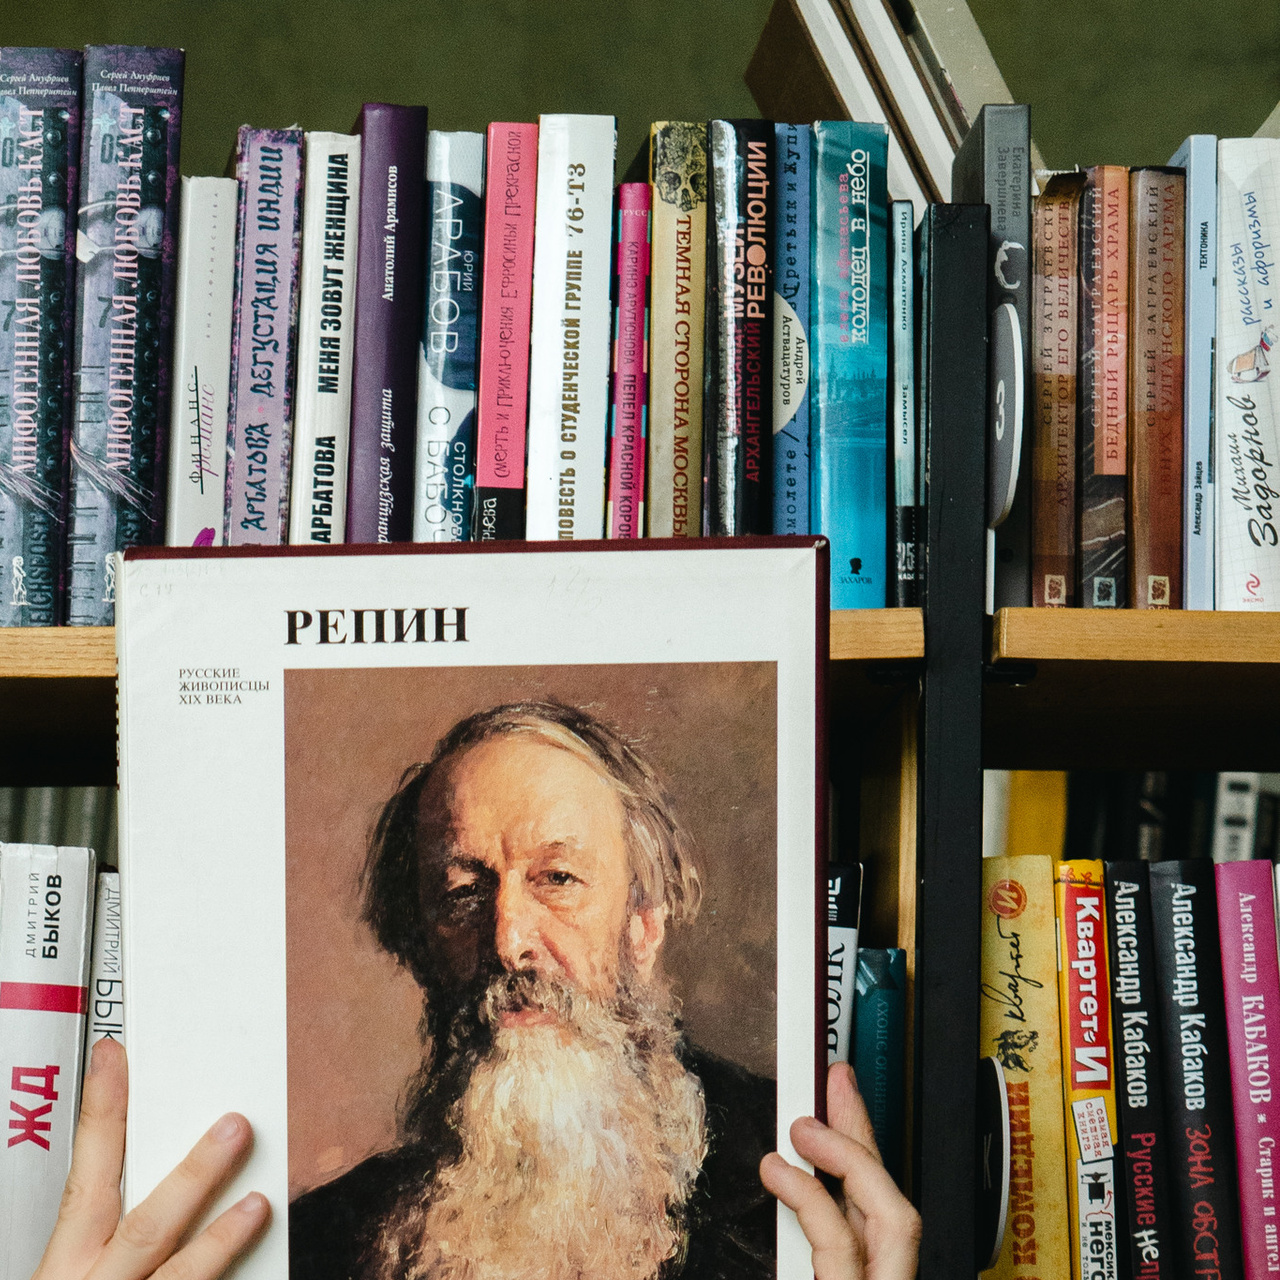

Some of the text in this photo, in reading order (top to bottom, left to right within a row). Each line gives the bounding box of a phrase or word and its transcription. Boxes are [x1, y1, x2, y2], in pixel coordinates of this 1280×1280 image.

[381, 165, 399, 302] Анатолий Арамисов
[431, 189, 464, 354] АРАБОВ
[463, 249, 474, 292] ЮРИЙ
[747, 141, 770, 318] РЕВОЛЮЦИИ
[310, 153, 350, 543] АРБАТОВА МЕНЯ ЗОВУТ ЖЕНЩИНА
[779, 315, 792, 405] Аствацатуров
[795, 336, 807, 385] Андрей
[1106, 187, 1120, 460] БЕДНЫЙ РЫЦАРЬ ХРАМА
[1193, 221, 1208, 536] Александр Зайцев ТЕКТОНИКА
[284, 607, 470, 646] РЕПИН
[179, 668, 240, 679] РУССКИЕ
[179, 681, 270, 692] ЖИВОПИСЦЫ
[179, 695, 242, 705] XIX ВЕКА
[24, 871, 40, 959] ДМИТРИЙ
[42, 873, 63, 960] БЫКОВ
[1071, 896, 1100, 1033] Квартет
[1113, 880, 1151, 1108] Александр Кабаков
[1170, 881, 1209, 1111] Александр Кабаков
[1238, 891, 1272, 1105] Александр КАБАКОВ
[7, 1064, 61, 1152] ЖД
[1074, 1046, 1108, 1083] И
[1084, 1102, 1103, 1157] смешная
[1096, 1107, 1110, 1148] самая
